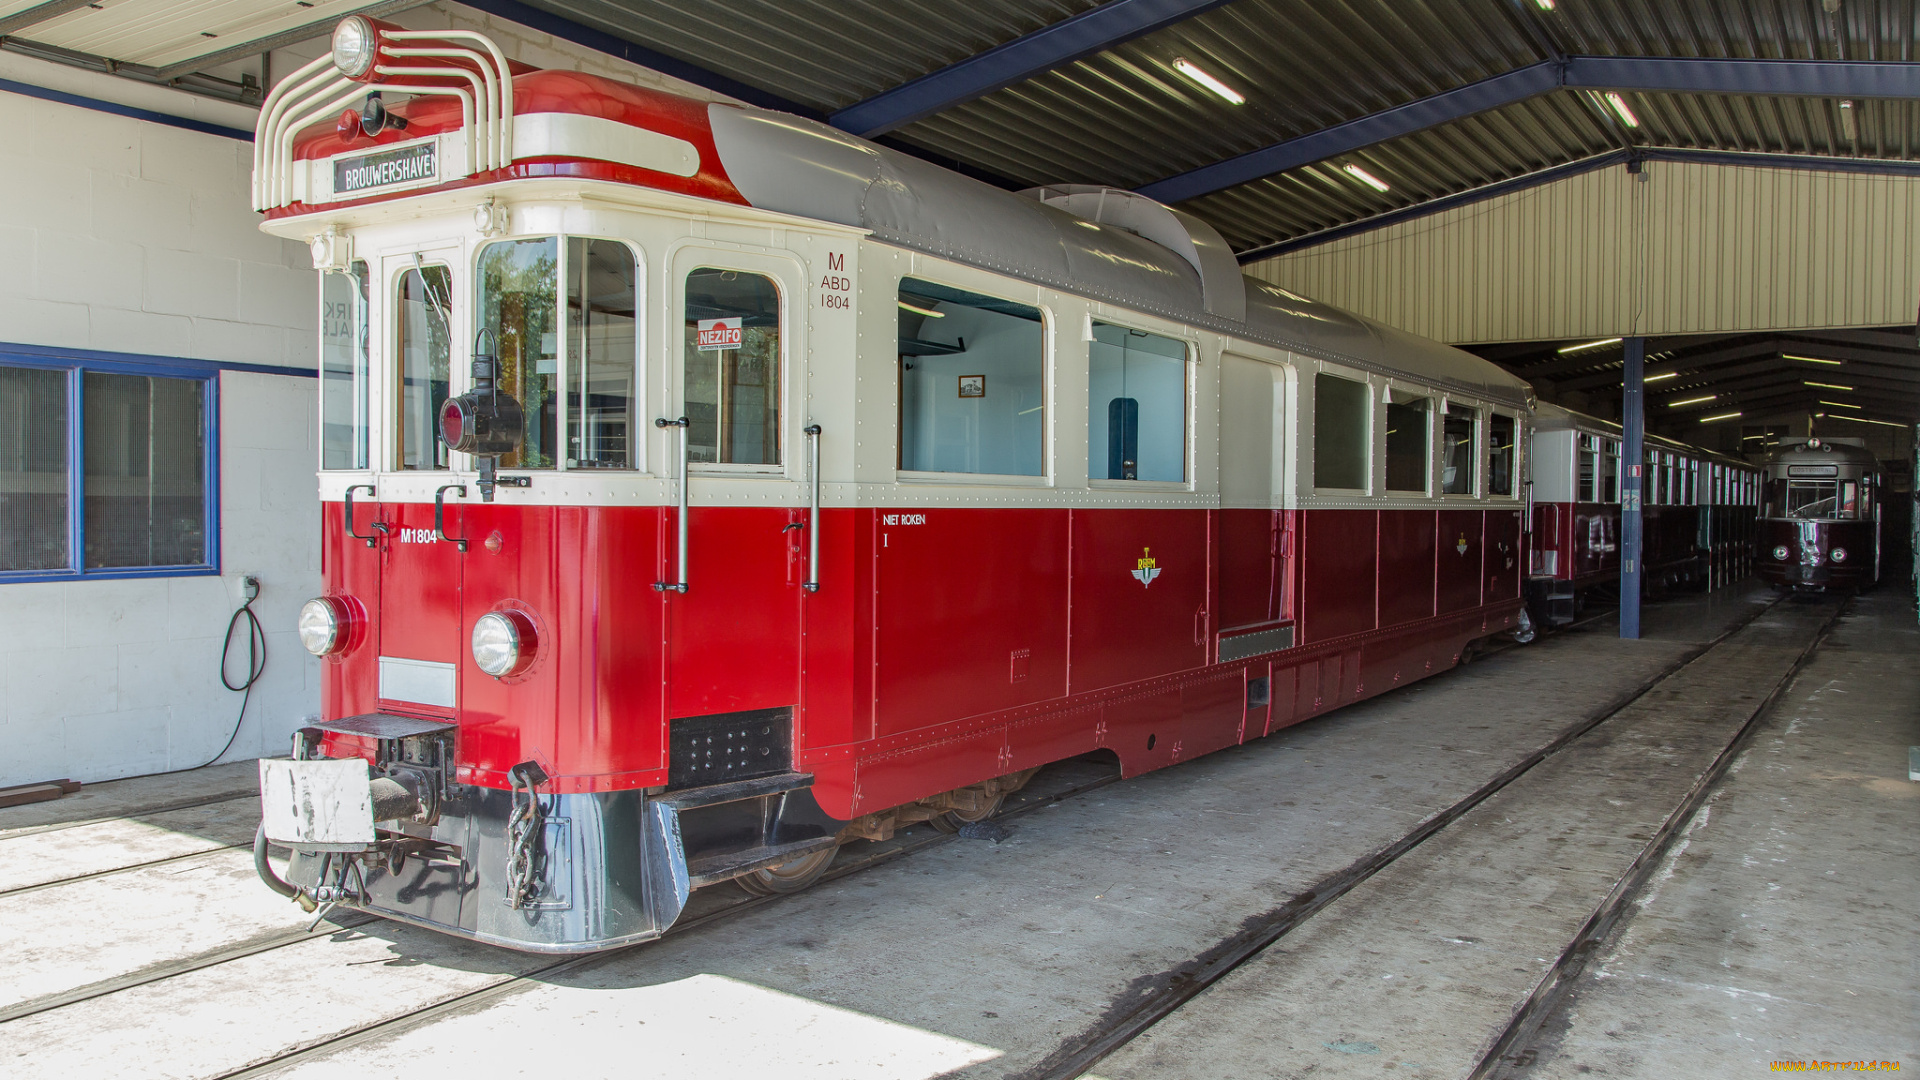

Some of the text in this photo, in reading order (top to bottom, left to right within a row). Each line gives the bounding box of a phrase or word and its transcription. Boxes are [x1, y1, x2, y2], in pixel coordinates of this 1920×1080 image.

[345, 153, 436, 190] BROUWERSHAVEN
[829, 251, 844, 271] M
[820, 275, 850, 291] ABD
[821, 293, 850, 310] 1804
[699, 329, 741, 345] NEZIFO
[883, 514, 926, 526] NIET ROKEN
[401, 528, 438, 544] M1804
